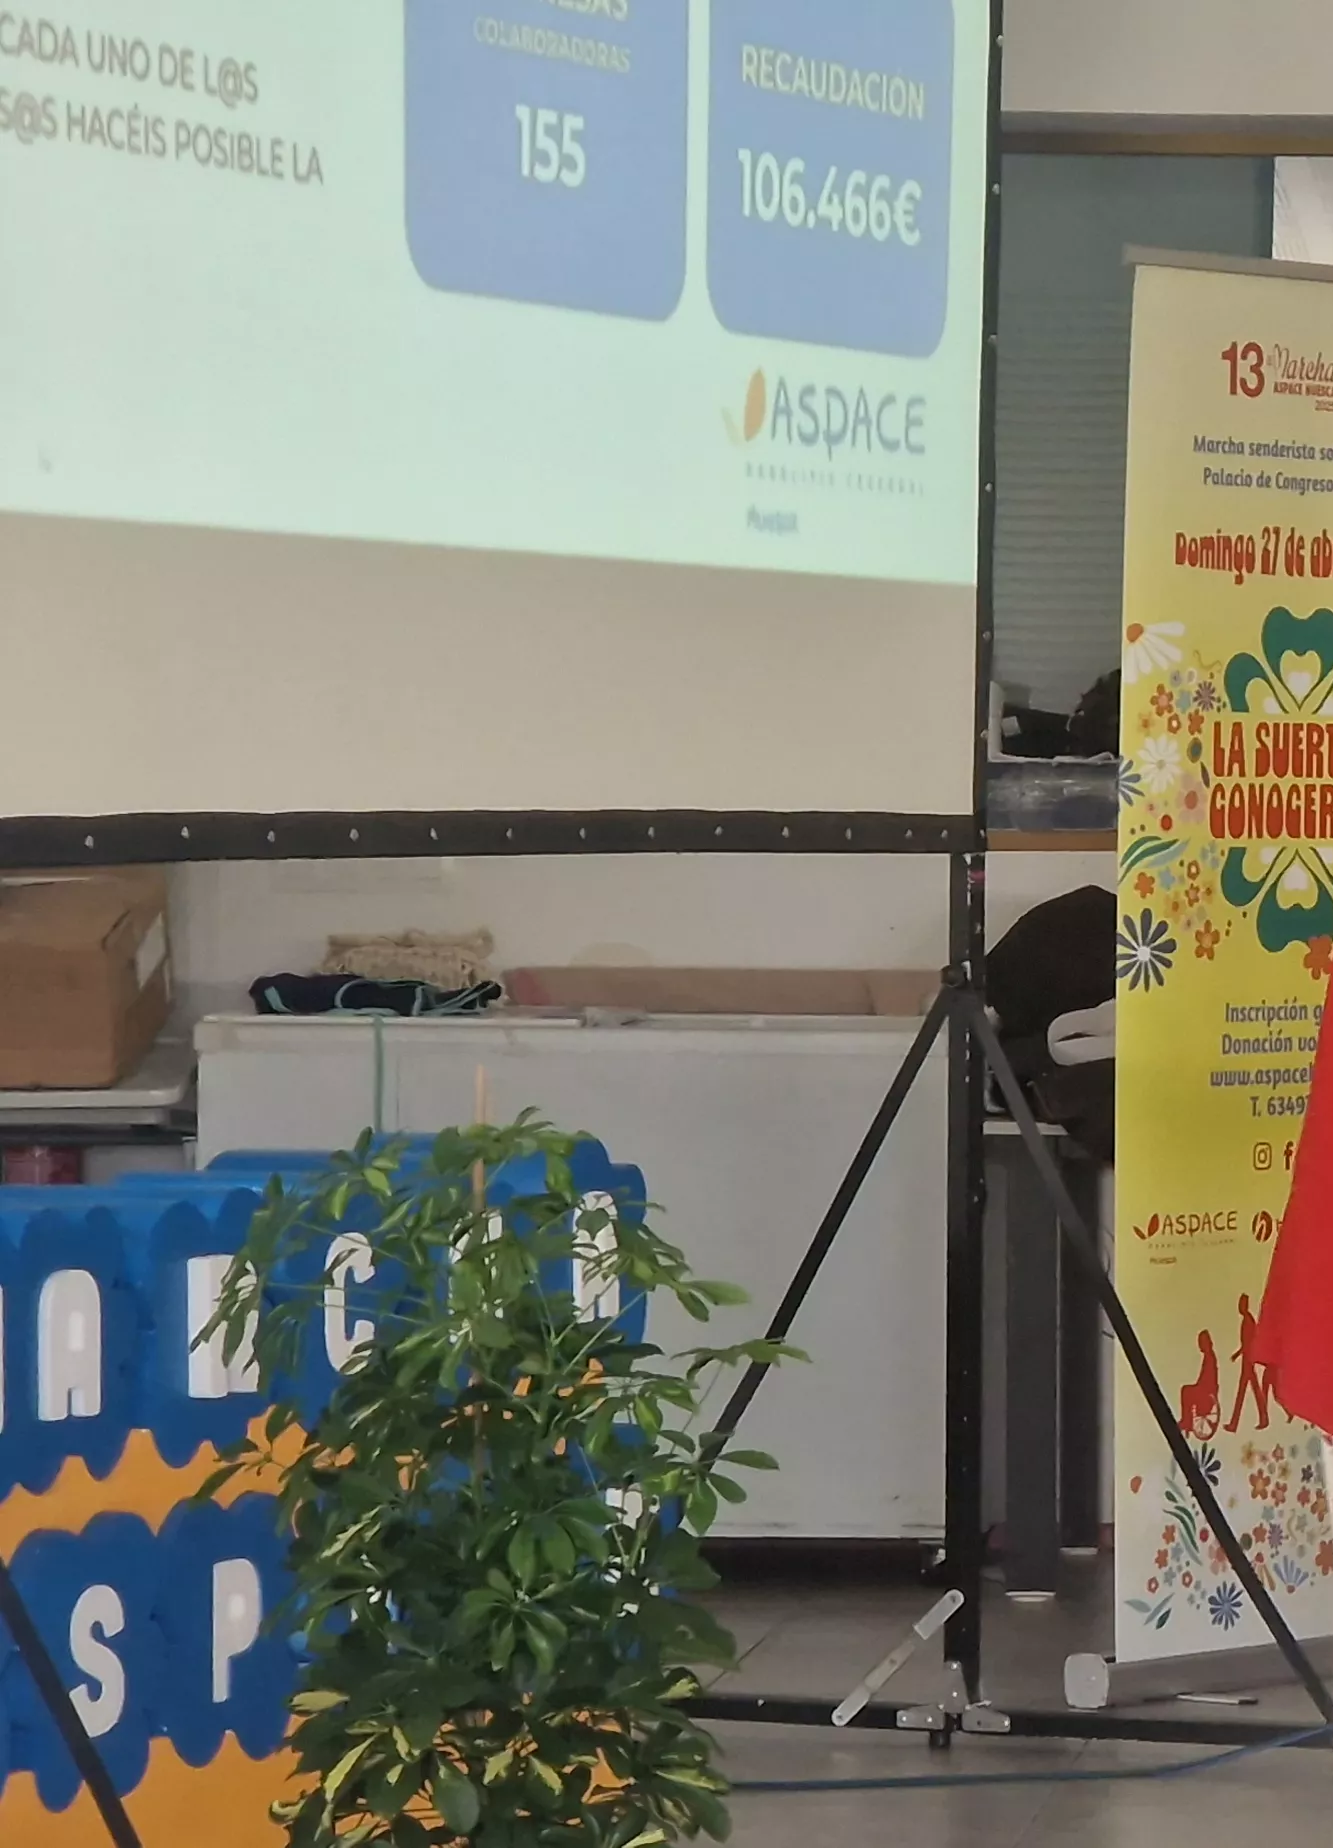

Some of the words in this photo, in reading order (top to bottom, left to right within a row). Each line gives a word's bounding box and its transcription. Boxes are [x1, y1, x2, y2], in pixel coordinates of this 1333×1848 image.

[0, 10, 79, 68] CADA
[87, 29, 150, 82] UNO
[158, 43, 195, 92] DE
[204, 54, 259, 109] L@S
[474, 16, 631, 73] COLABORADORAS
[66, 101, 167, 158] HACÉIS
[174, 119, 285, 180] POSIBLE
[292, 142, 324, 186] LA
[515, 103, 586, 188] 155
[737, 147, 922, 246] 106.466€
[770, 376, 927, 462] ASPACE
[1193, 435, 1245, 456] Marcha
[1248, 440, 1316, 461] senderista
[1203, 467, 1252, 488] Palacio
[1256, 470, 1271, 489] de
[1175, 529, 1256, 585] Domingo
[1261, 526, 1281, 576] 27
[1284, 527, 1305, 578] de
[1213, 721, 1246, 778] LA
[1225, 996, 1308, 1027] Inscripción
[1222, 1029, 1292, 1055] Donación
[1250, 1096, 1262, 1117] T.
[1162, 1210, 1238, 1237] ASPACE
